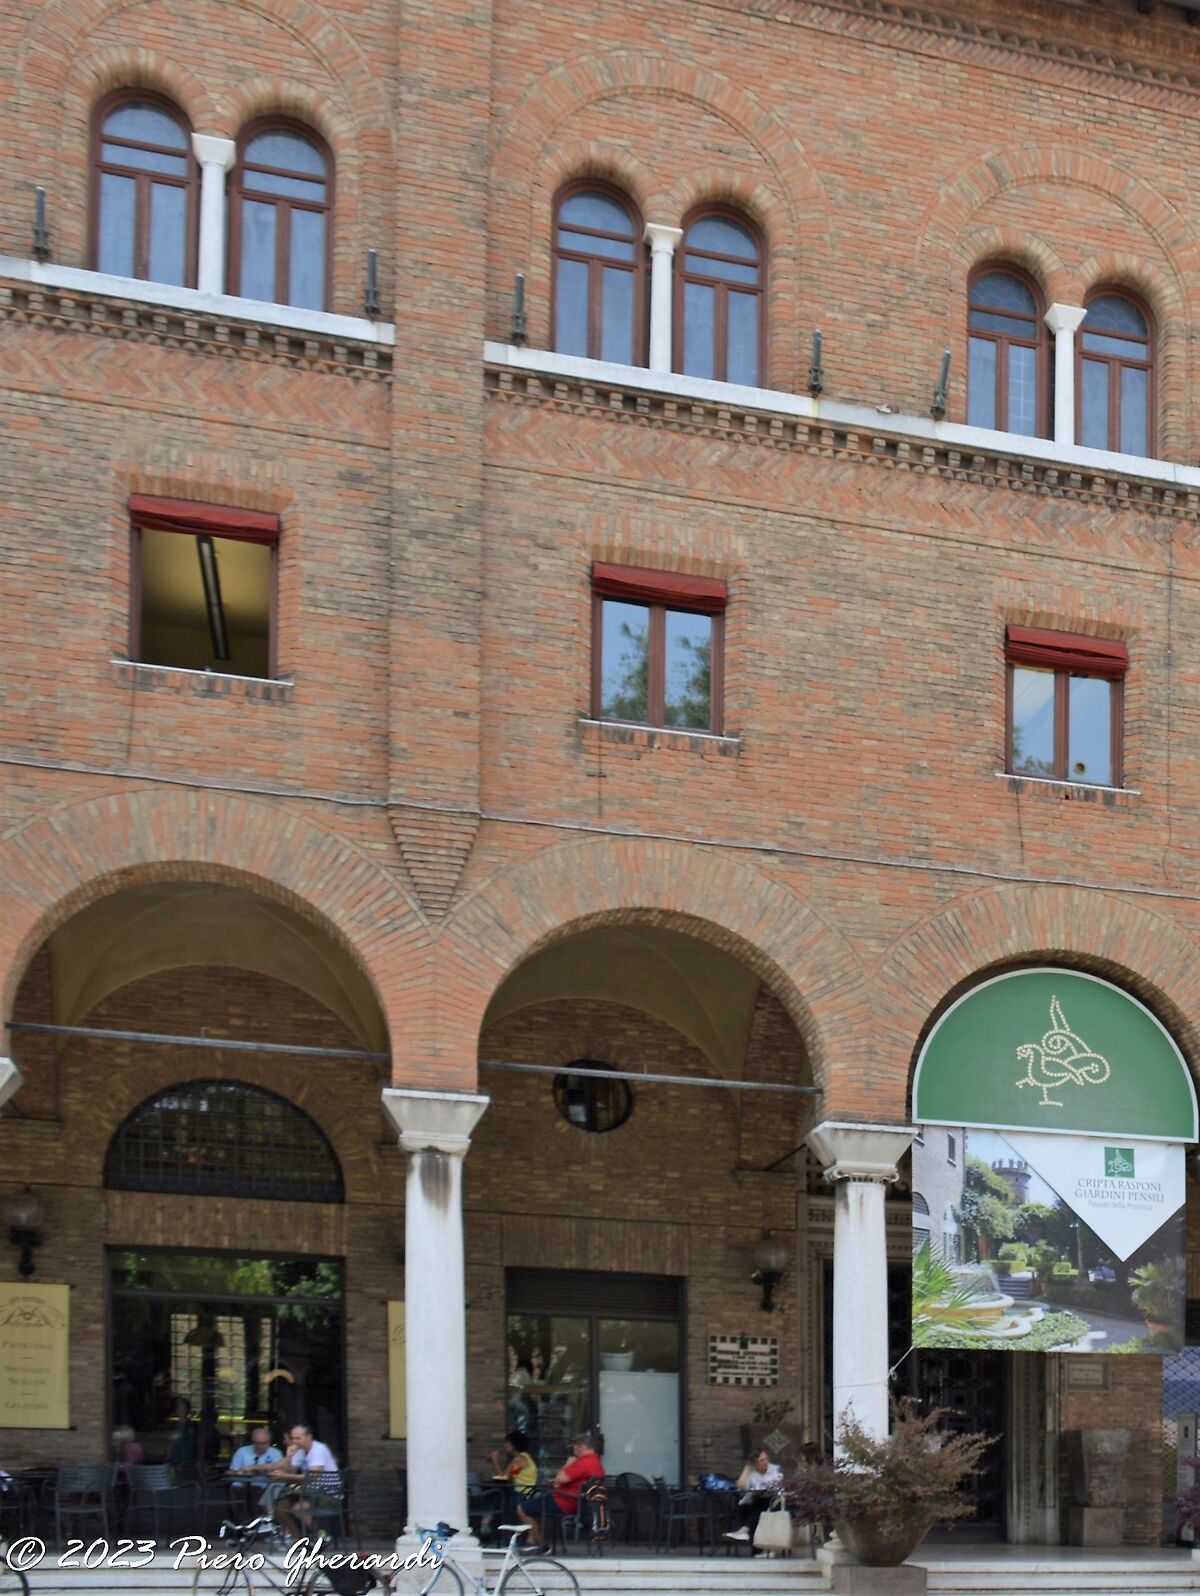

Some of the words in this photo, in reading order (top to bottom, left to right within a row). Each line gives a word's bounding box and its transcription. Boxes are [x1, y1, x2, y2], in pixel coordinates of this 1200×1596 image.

[1078, 1178, 1115, 1189] CRIPTA
[1118, 1180, 1161, 1192] RASPONI
[1074, 1188, 1126, 1201] GIARDINI
[1128, 1191, 1165, 1203] PENSILI
